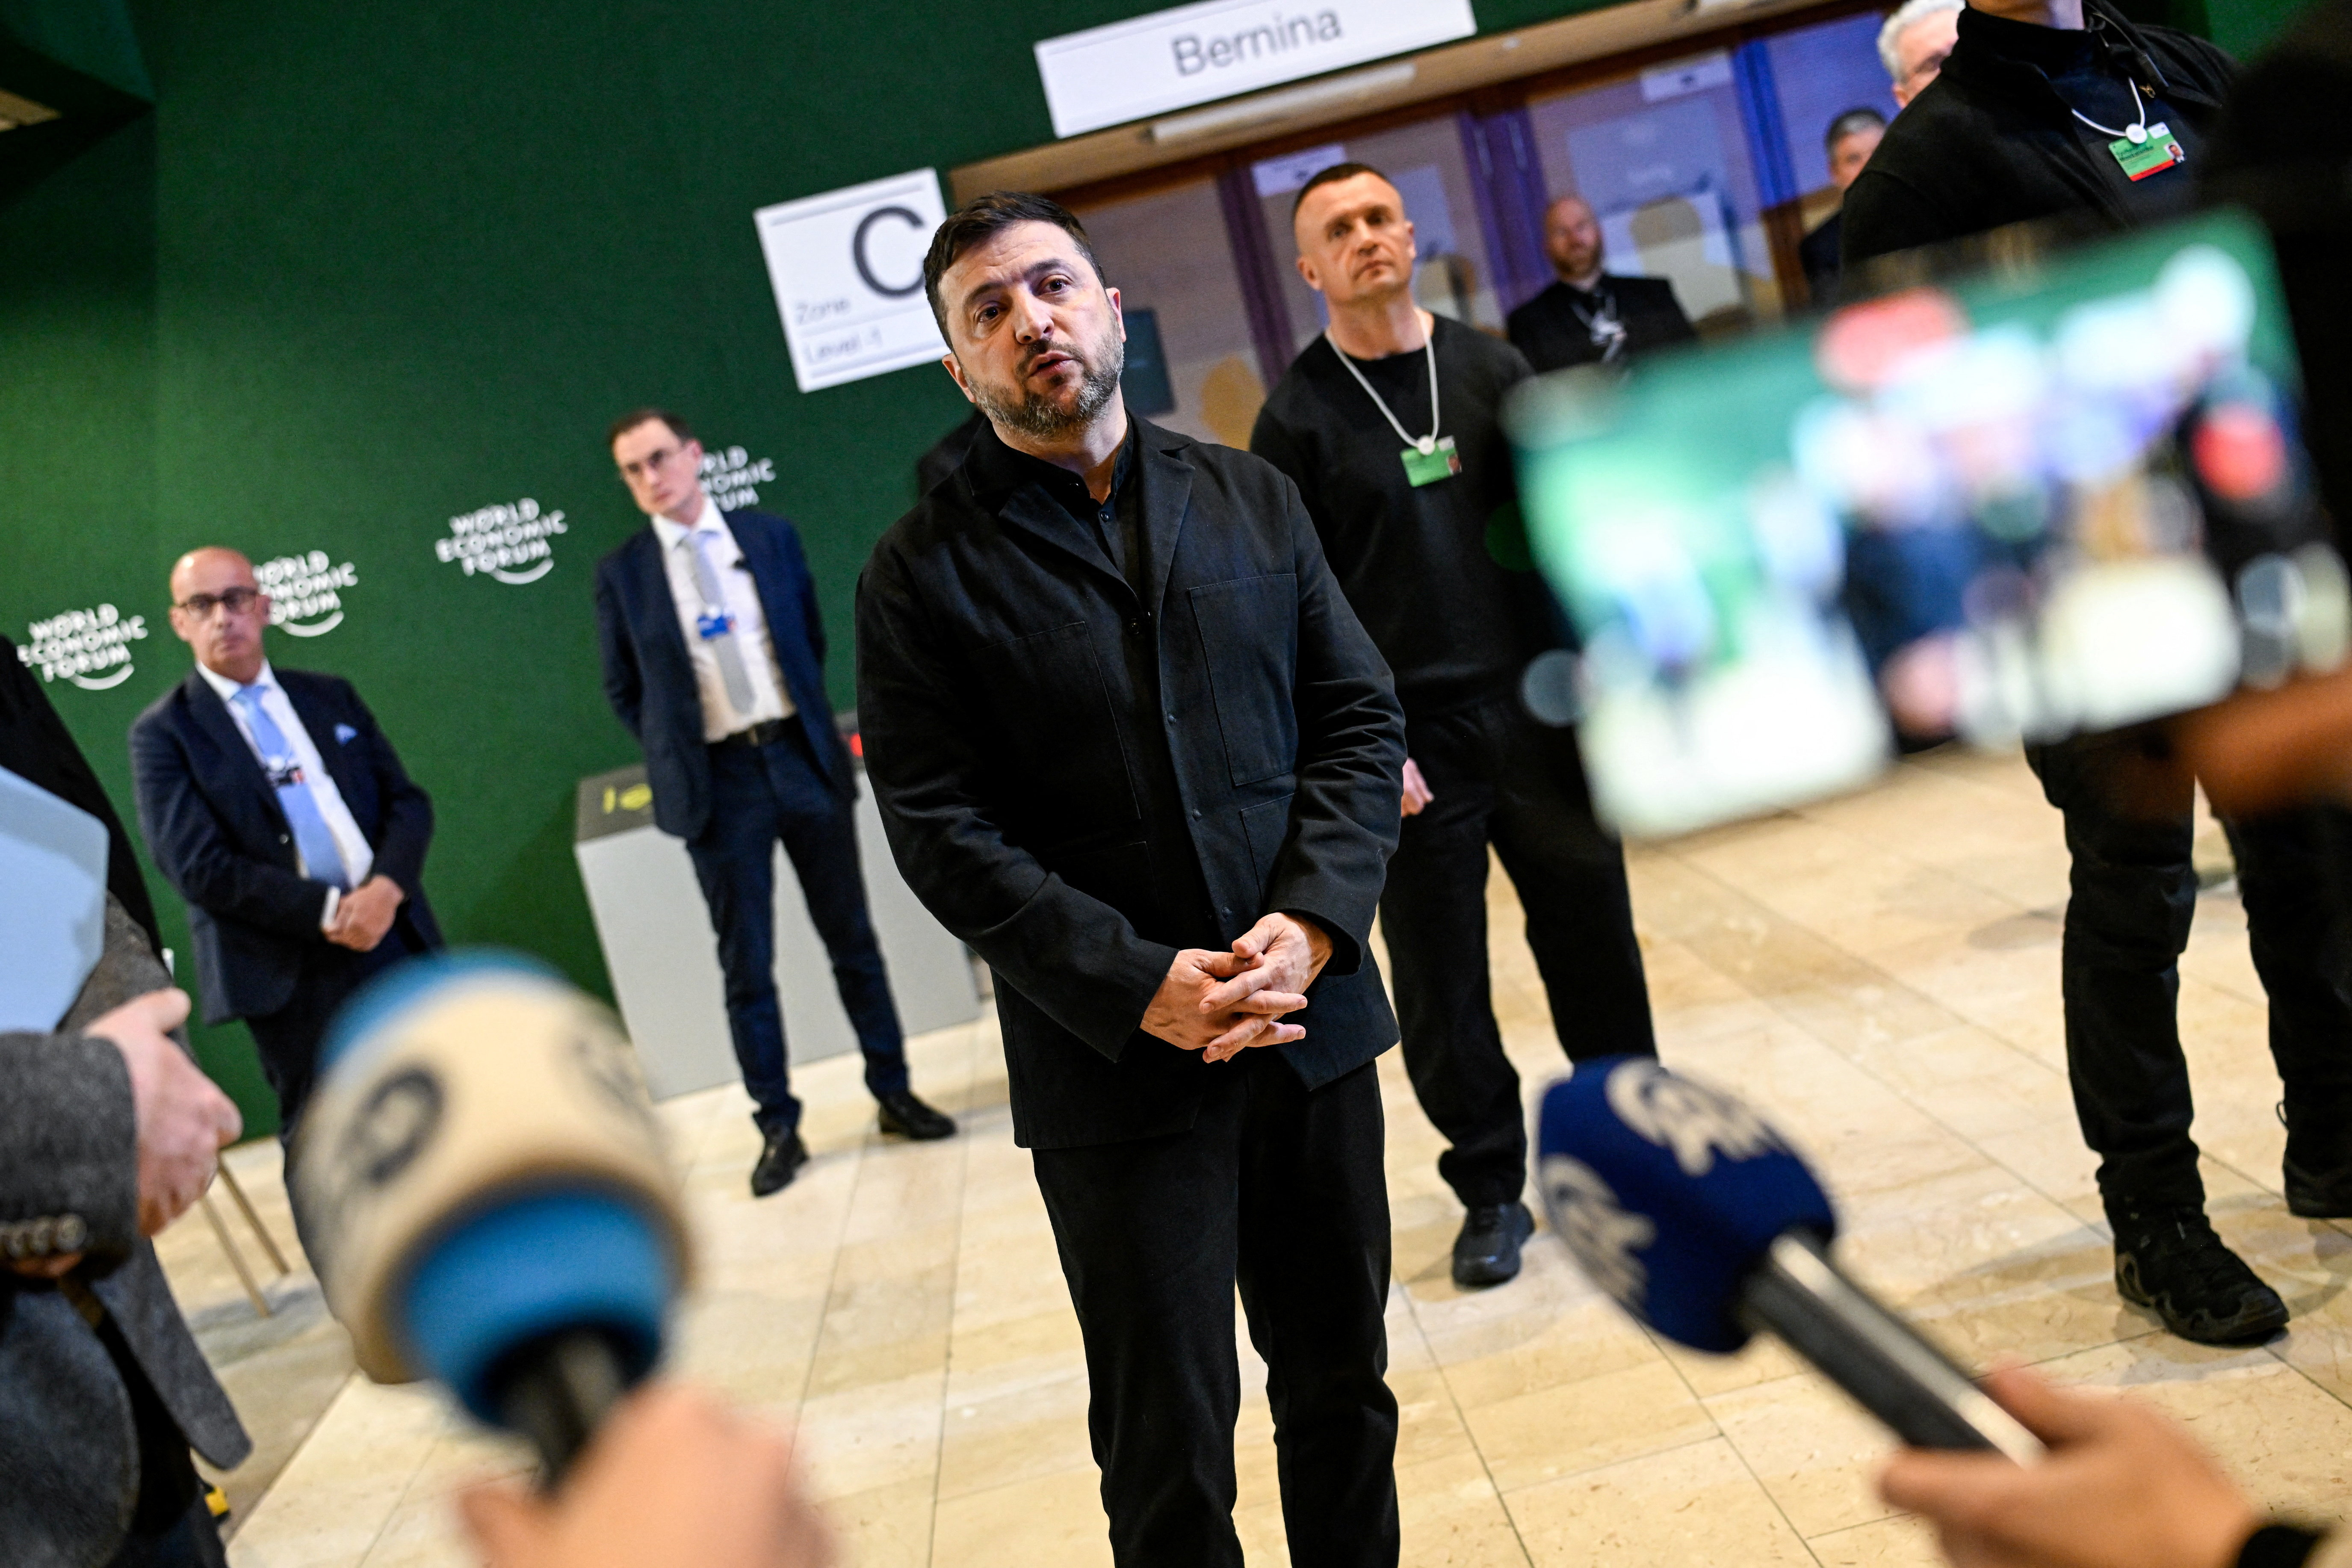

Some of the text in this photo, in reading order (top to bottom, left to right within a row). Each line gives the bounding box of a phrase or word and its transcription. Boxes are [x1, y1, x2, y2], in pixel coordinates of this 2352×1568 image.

[1172, 7, 1344, 77] Bernina
[854, 205, 926, 300] C
[796, 298, 852, 326] Zone
[803, 332, 863, 365] Level
[450, 497, 539, 536] WORLD
[435, 510, 568, 563] ECONOMIC
[461, 537, 551, 576] FORUM
[29, 603, 118, 641] WORLD
[269, 590, 341, 626] ORUM
[42, 643, 131, 682] FORUM
